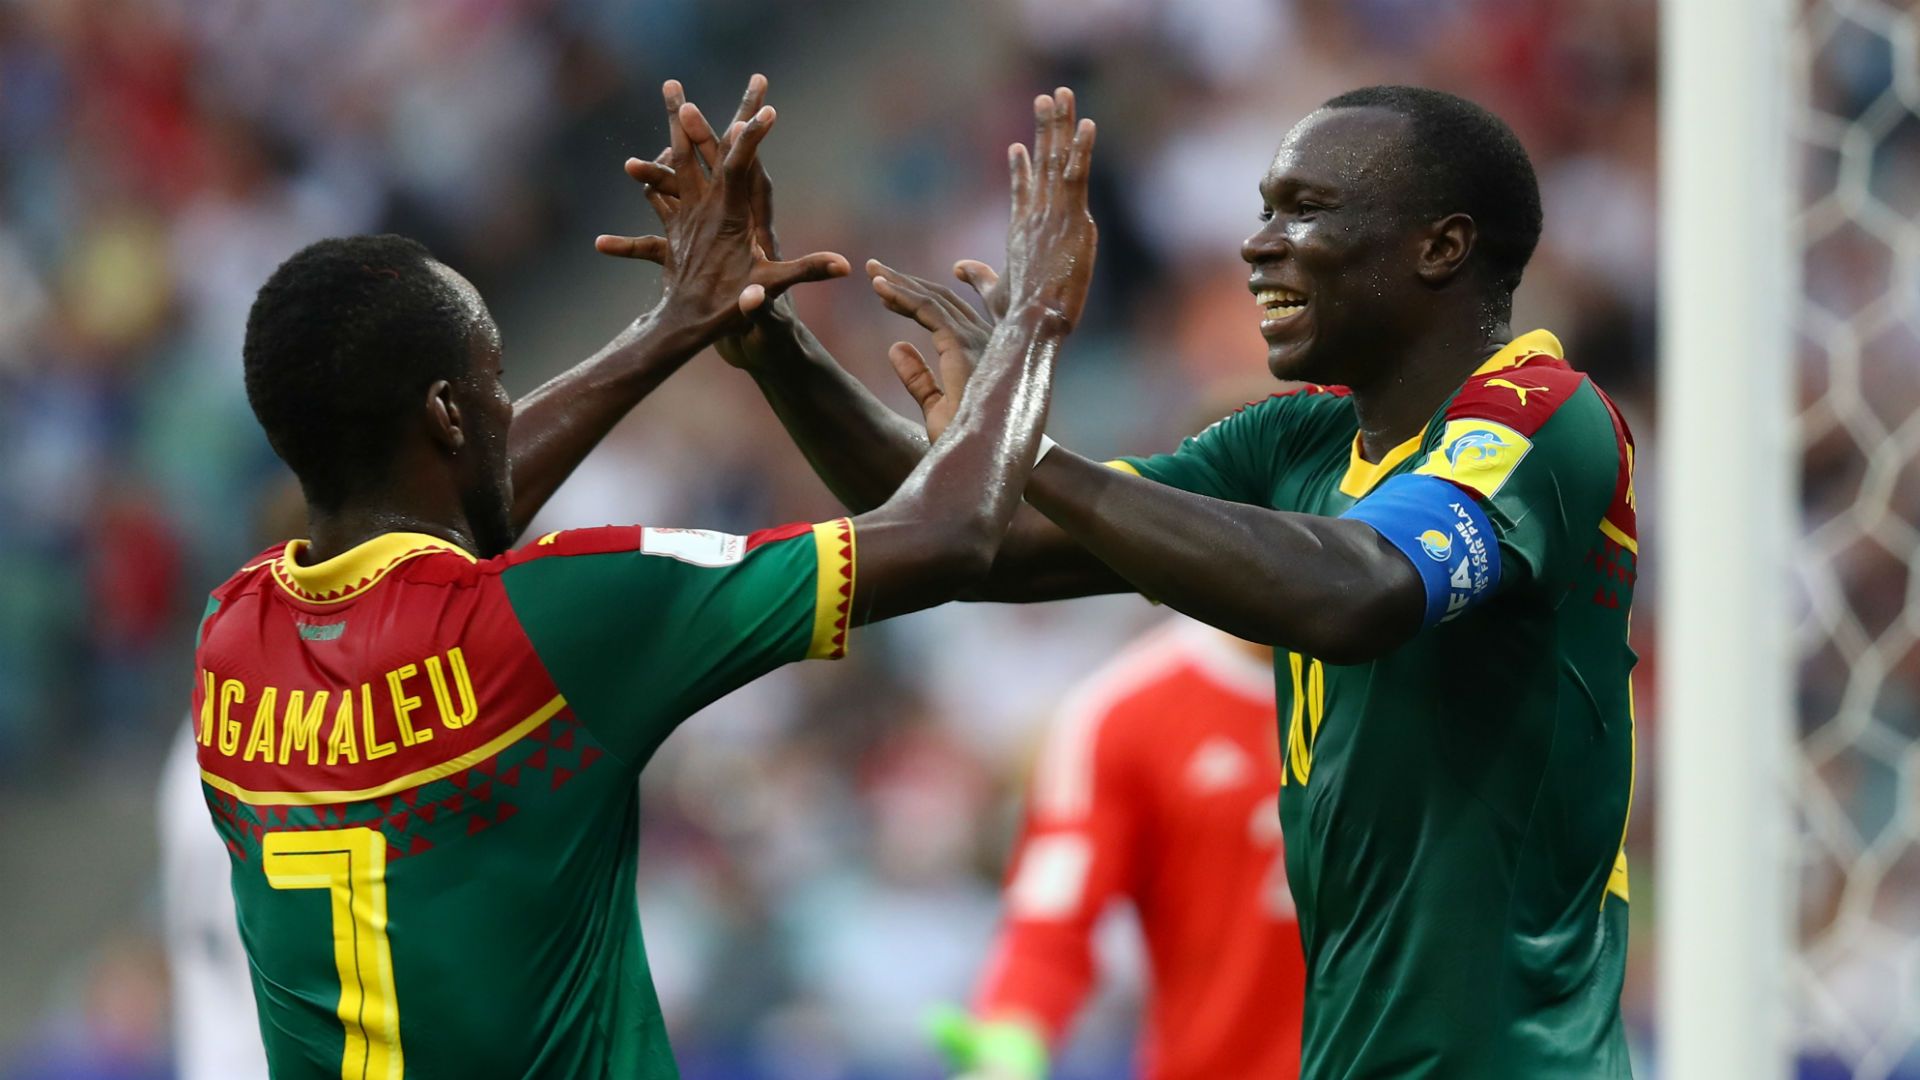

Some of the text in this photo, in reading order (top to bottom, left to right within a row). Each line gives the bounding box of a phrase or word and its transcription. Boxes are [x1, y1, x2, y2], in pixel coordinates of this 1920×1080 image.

[1449, 502, 1478, 535] PLAY
[1455, 521, 1480, 566] GAME
[1475, 538, 1488, 572] FAIR
[1436, 555, 1472, 626] IFA
[262, 827, 404, 1080] 7
